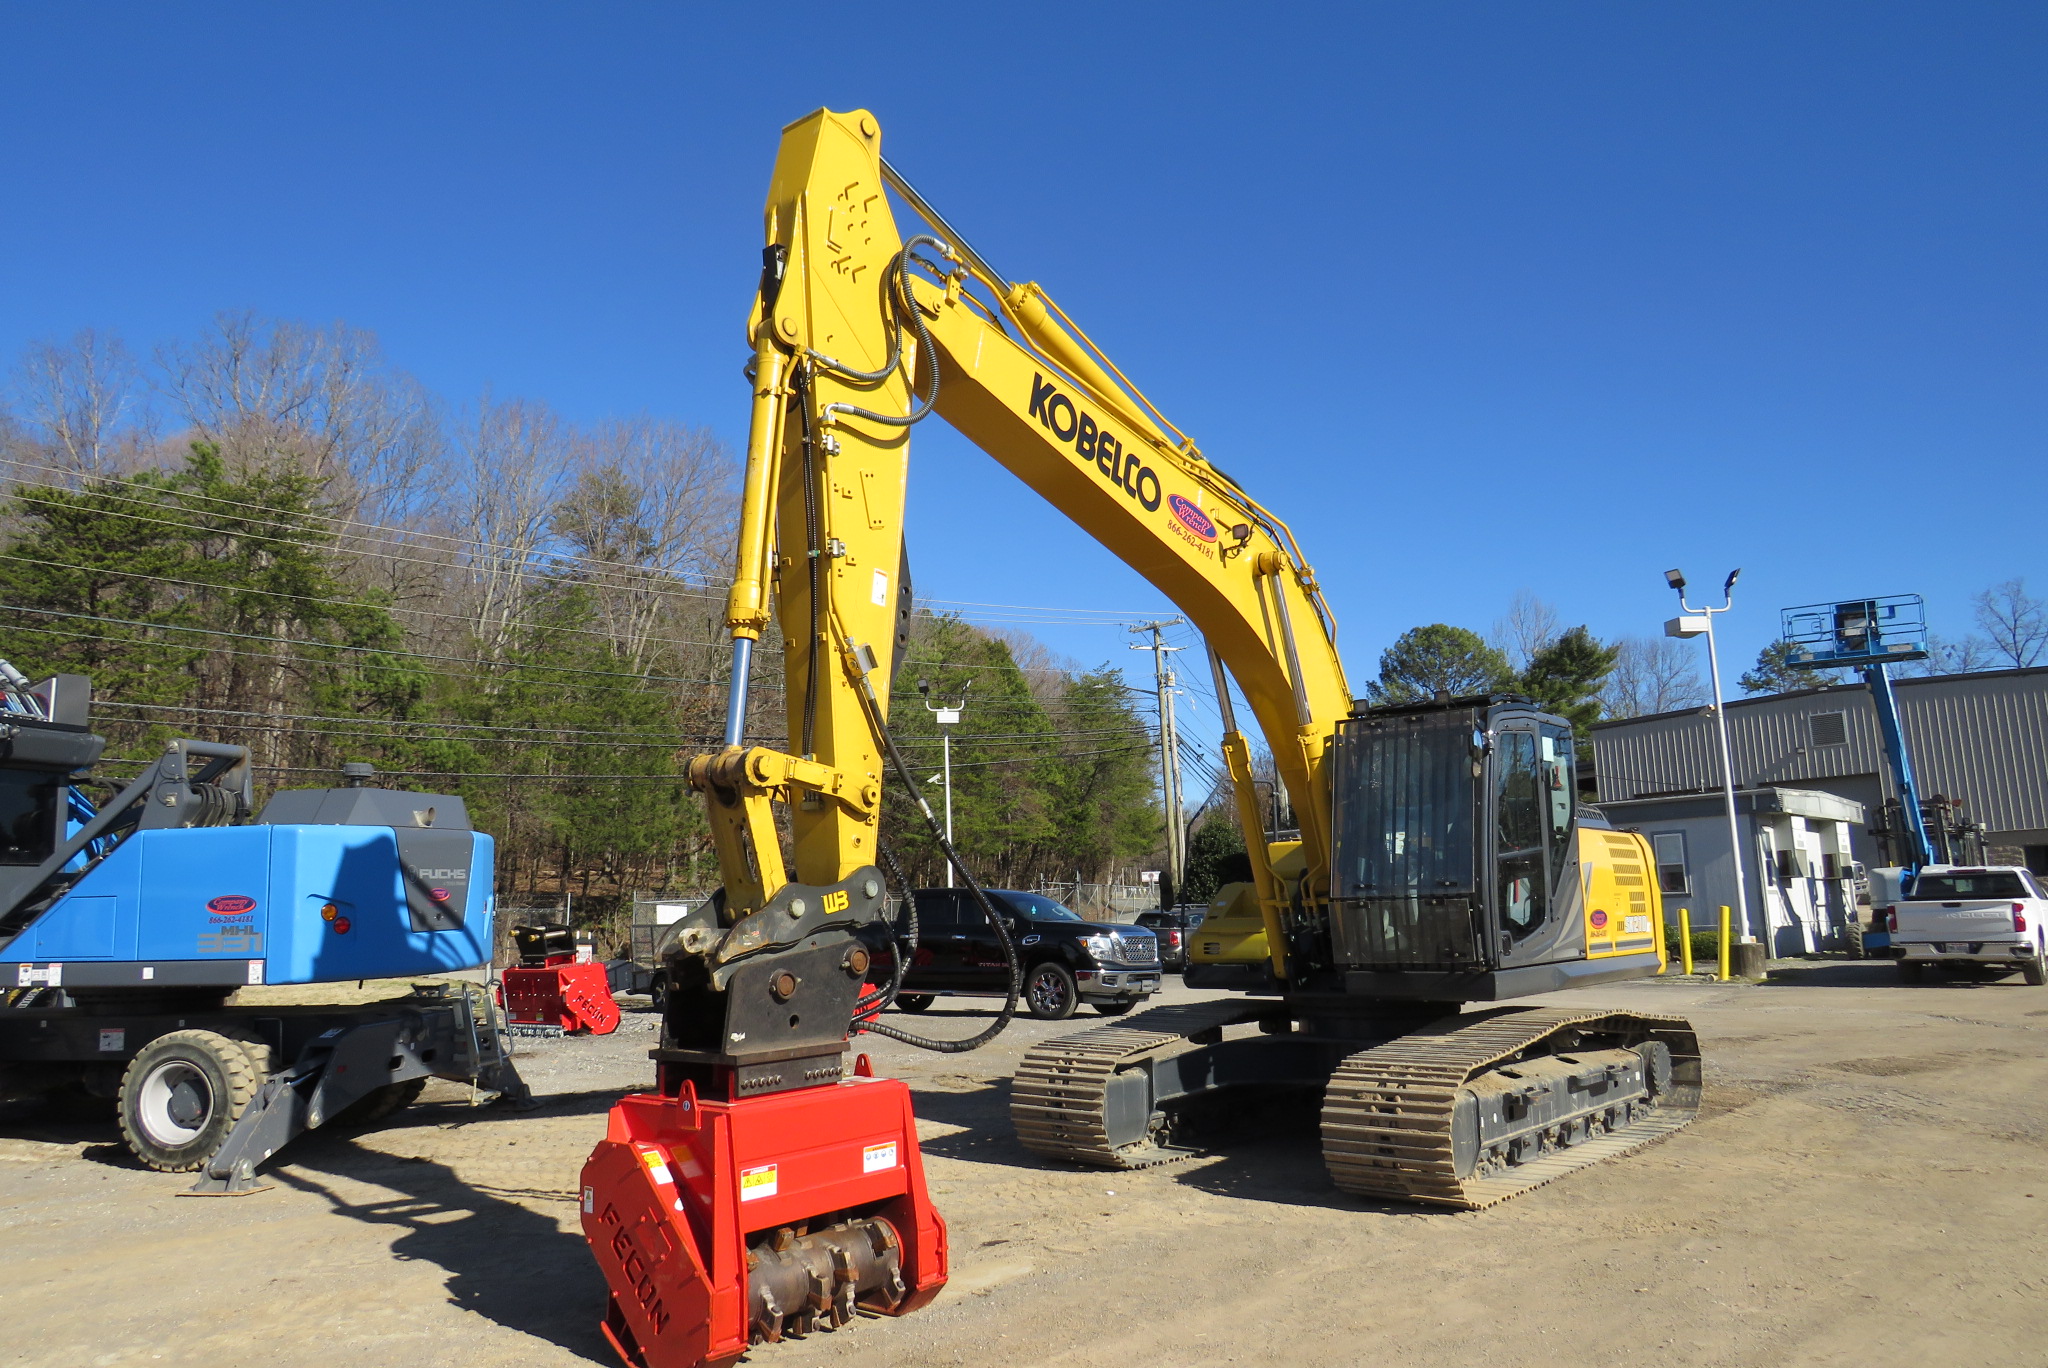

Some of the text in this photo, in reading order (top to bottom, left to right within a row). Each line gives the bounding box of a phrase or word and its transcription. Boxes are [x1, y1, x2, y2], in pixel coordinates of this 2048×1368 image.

[1028, 371, 1162, 513] KOBELCO
[1174, 497, 1212, 530] Company
[1178, 506, 1207, 535] Wrench
[1167, 519, 1214, 560] 866-262-4181
[419, 868, 466, 879] FUCHS
[221, 925, 260, 936] MHL
[575, 994, 610, 1026] FECON
[600, 1202, 670, 1336] FECON
